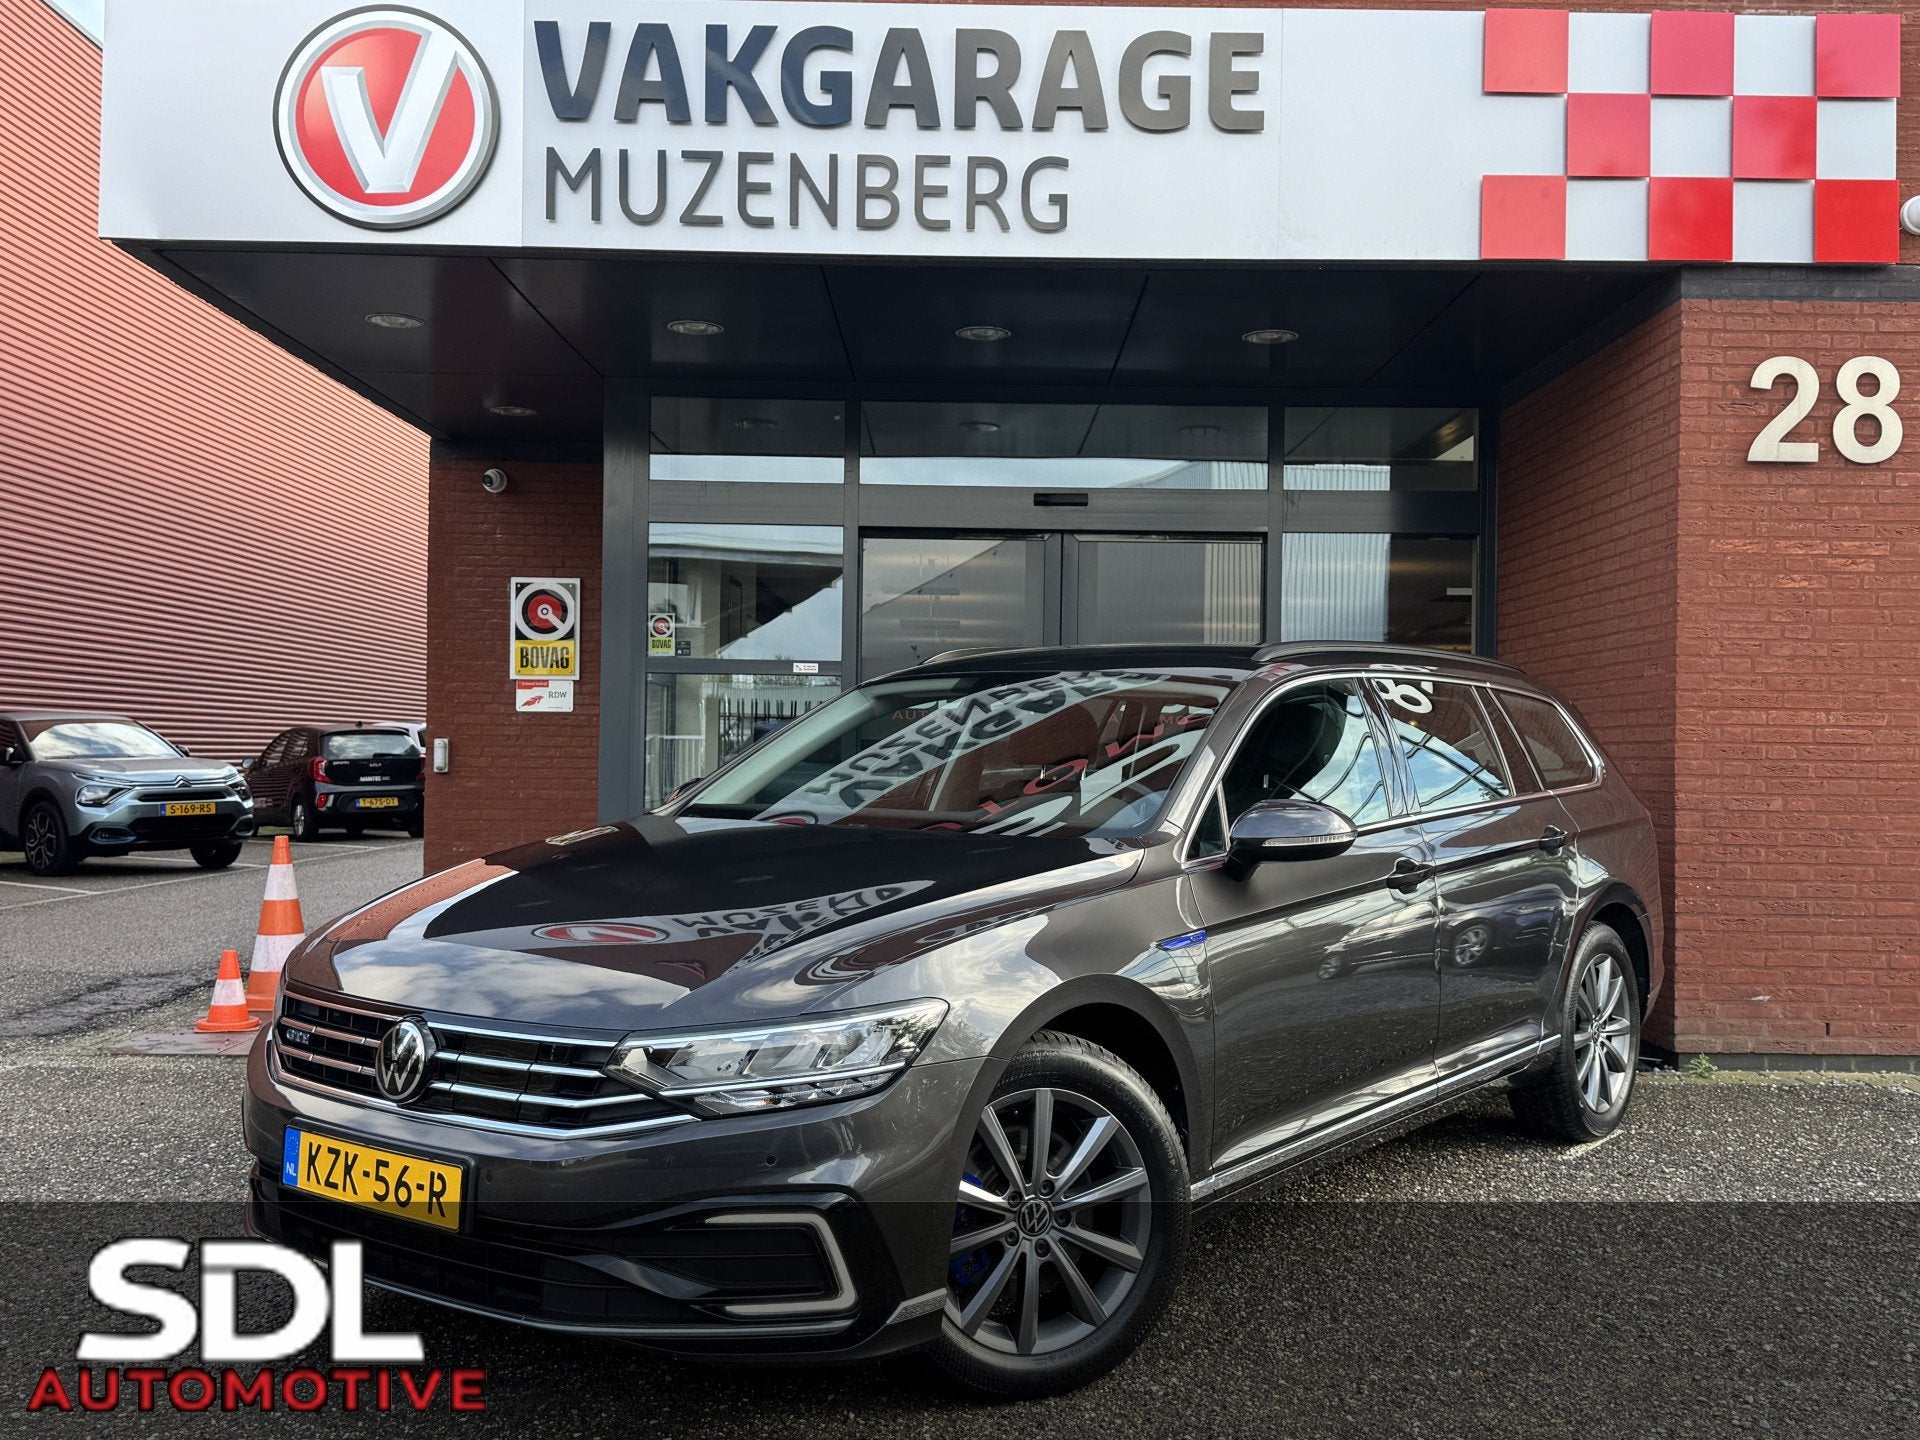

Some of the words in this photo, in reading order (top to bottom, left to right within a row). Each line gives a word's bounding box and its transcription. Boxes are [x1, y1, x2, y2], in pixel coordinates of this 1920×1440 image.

[534, 21, 1264, 131] VAKGARAGE
[545, 146, 1069, 234] MUZENBERG
[1747, 355, 1903, 464] 28
[652, 639, 672, 649] BOVAG
[520, 646, 569, 669] BOVAG
[548, 691, 568, 699] RDW
[170, 803, 212, 815] S-169-RS
[363, 798, 396, 807] T-675-DT
[285, 1161, 297, 1177] NL
[306, 1142, 447, 1218] KZK-56-R
